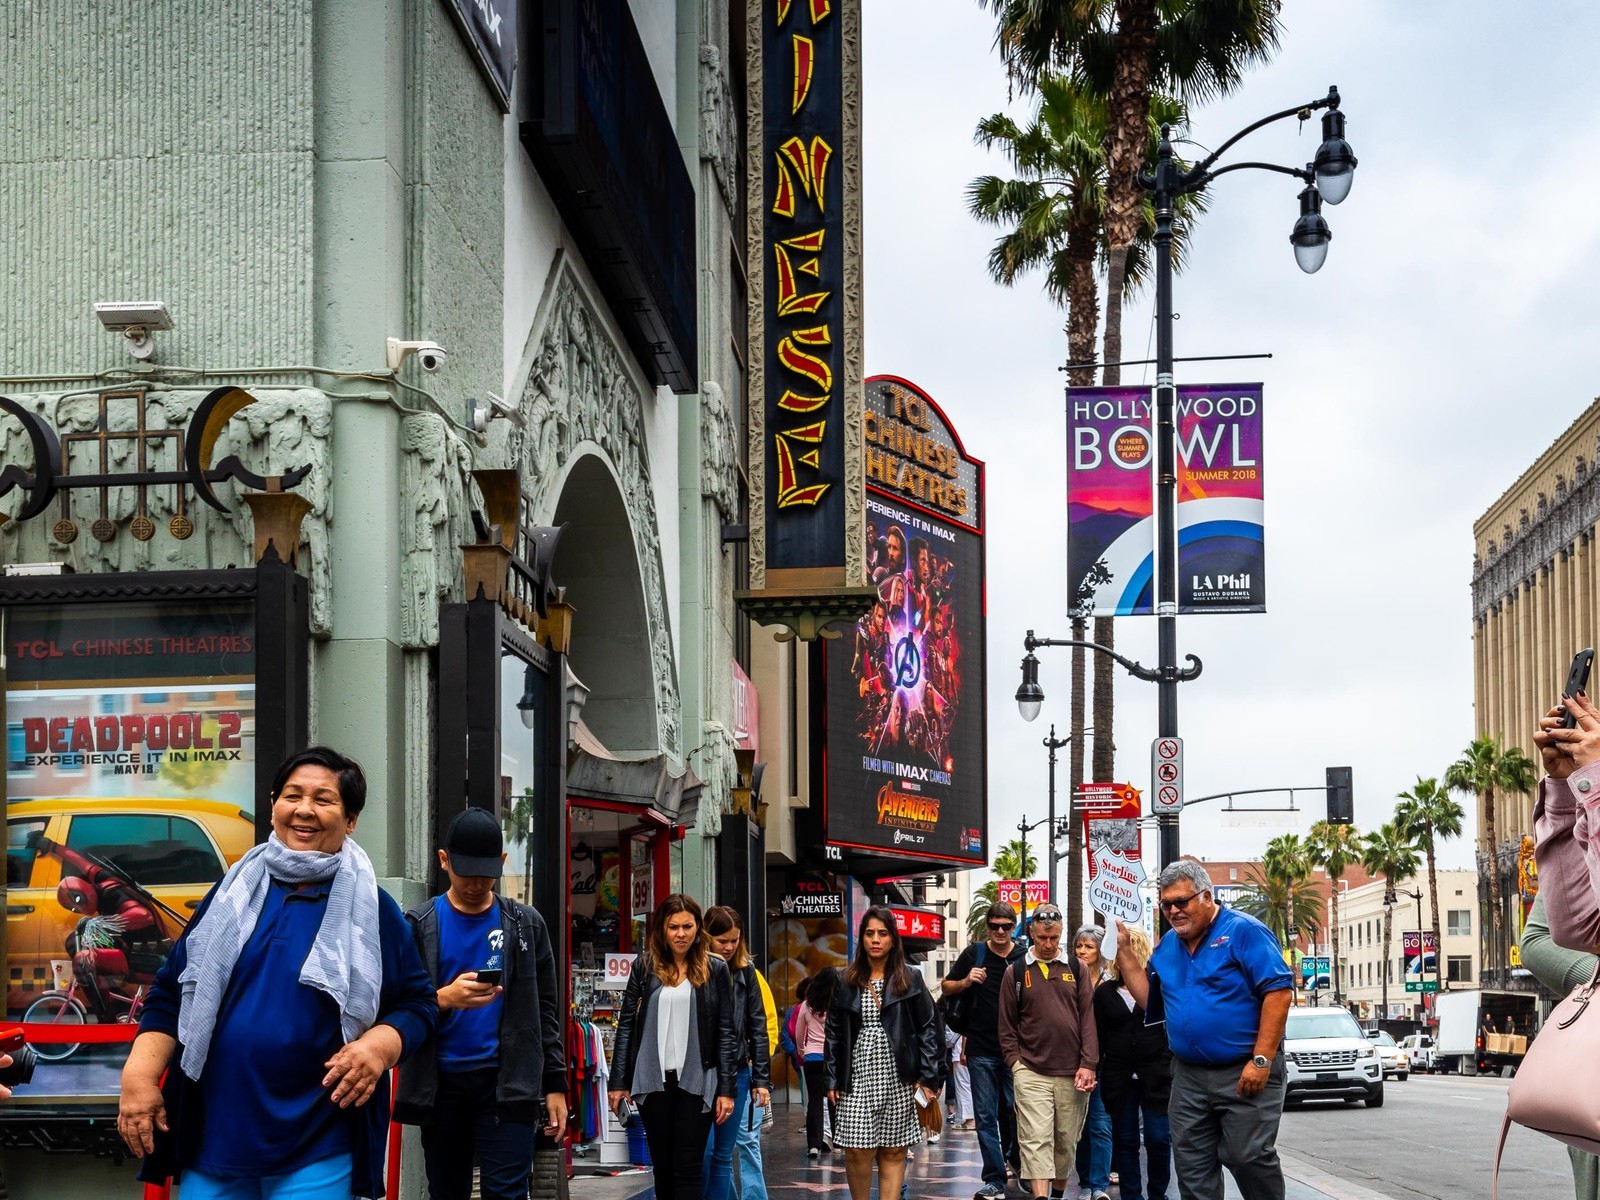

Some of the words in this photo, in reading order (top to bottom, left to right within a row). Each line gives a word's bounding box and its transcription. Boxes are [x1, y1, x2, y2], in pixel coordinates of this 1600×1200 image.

[887, 384, 932, 432] TCL
[864, 410, 959, 479] CHINESE
[1117, 444, 1146, 452] SUMMER
[865, 446, 968, 515] HEATRES
[1185, 470, 1229, 481] SUMMER
[1232, 469, 1256, 480] 2018
[866, 499, 911, 526] PERIENCE
[912, 517, 921, 529] IT
[921, 519, 931, 532] IN
[932, 523, 956, 542] IMAX
[1192, 575, 1214, 590] LA
[1217, 573, 1251, 590] Phil
[13, 640, 64, 661] TCL
[72, 637, 154, 657] CHINESE
[159, 635, 253, 655] THEATRES
[22, 711, 214, 754] DEADPOOL
[218, 710, 242, 750] 2
[25, 753, 141, 767] EXPERIENCE
[147, 752, 163, 763] IT
[169, 751, 188, 763] IN
[193, 750, 242, 762] IMAX
[114, 765, 140, 775] MAY
[141, 764, 154, 774] 18
[862, 755, 882, 772] FILMED
[882, 759, 895, 775] WITH
[895, 763, 929, 782] IMAX
[929, 769, 952, 786] CAMERAS
[877, 781, 941, 825] AVENGERS
[884, 816, 918, 830] INFINITY
[919, 821, 936, 832] WAR
[916, 835, 925, 843] 27
[825, 846, 842, 860] TCL
[796, 882, 826, 892] TCL
[1103, 880, 1132, 898] GRAND
[795, 895, 840, 905] CHINESE
[1094, 888, 1114, 902] CITY
[1115, 896, 1138, 913] TOUR
[795, 904, 841, 914] THEATRES
[1101, 902, 1112, 913] OF
[1113, 907, 1128, 920] L.A.
